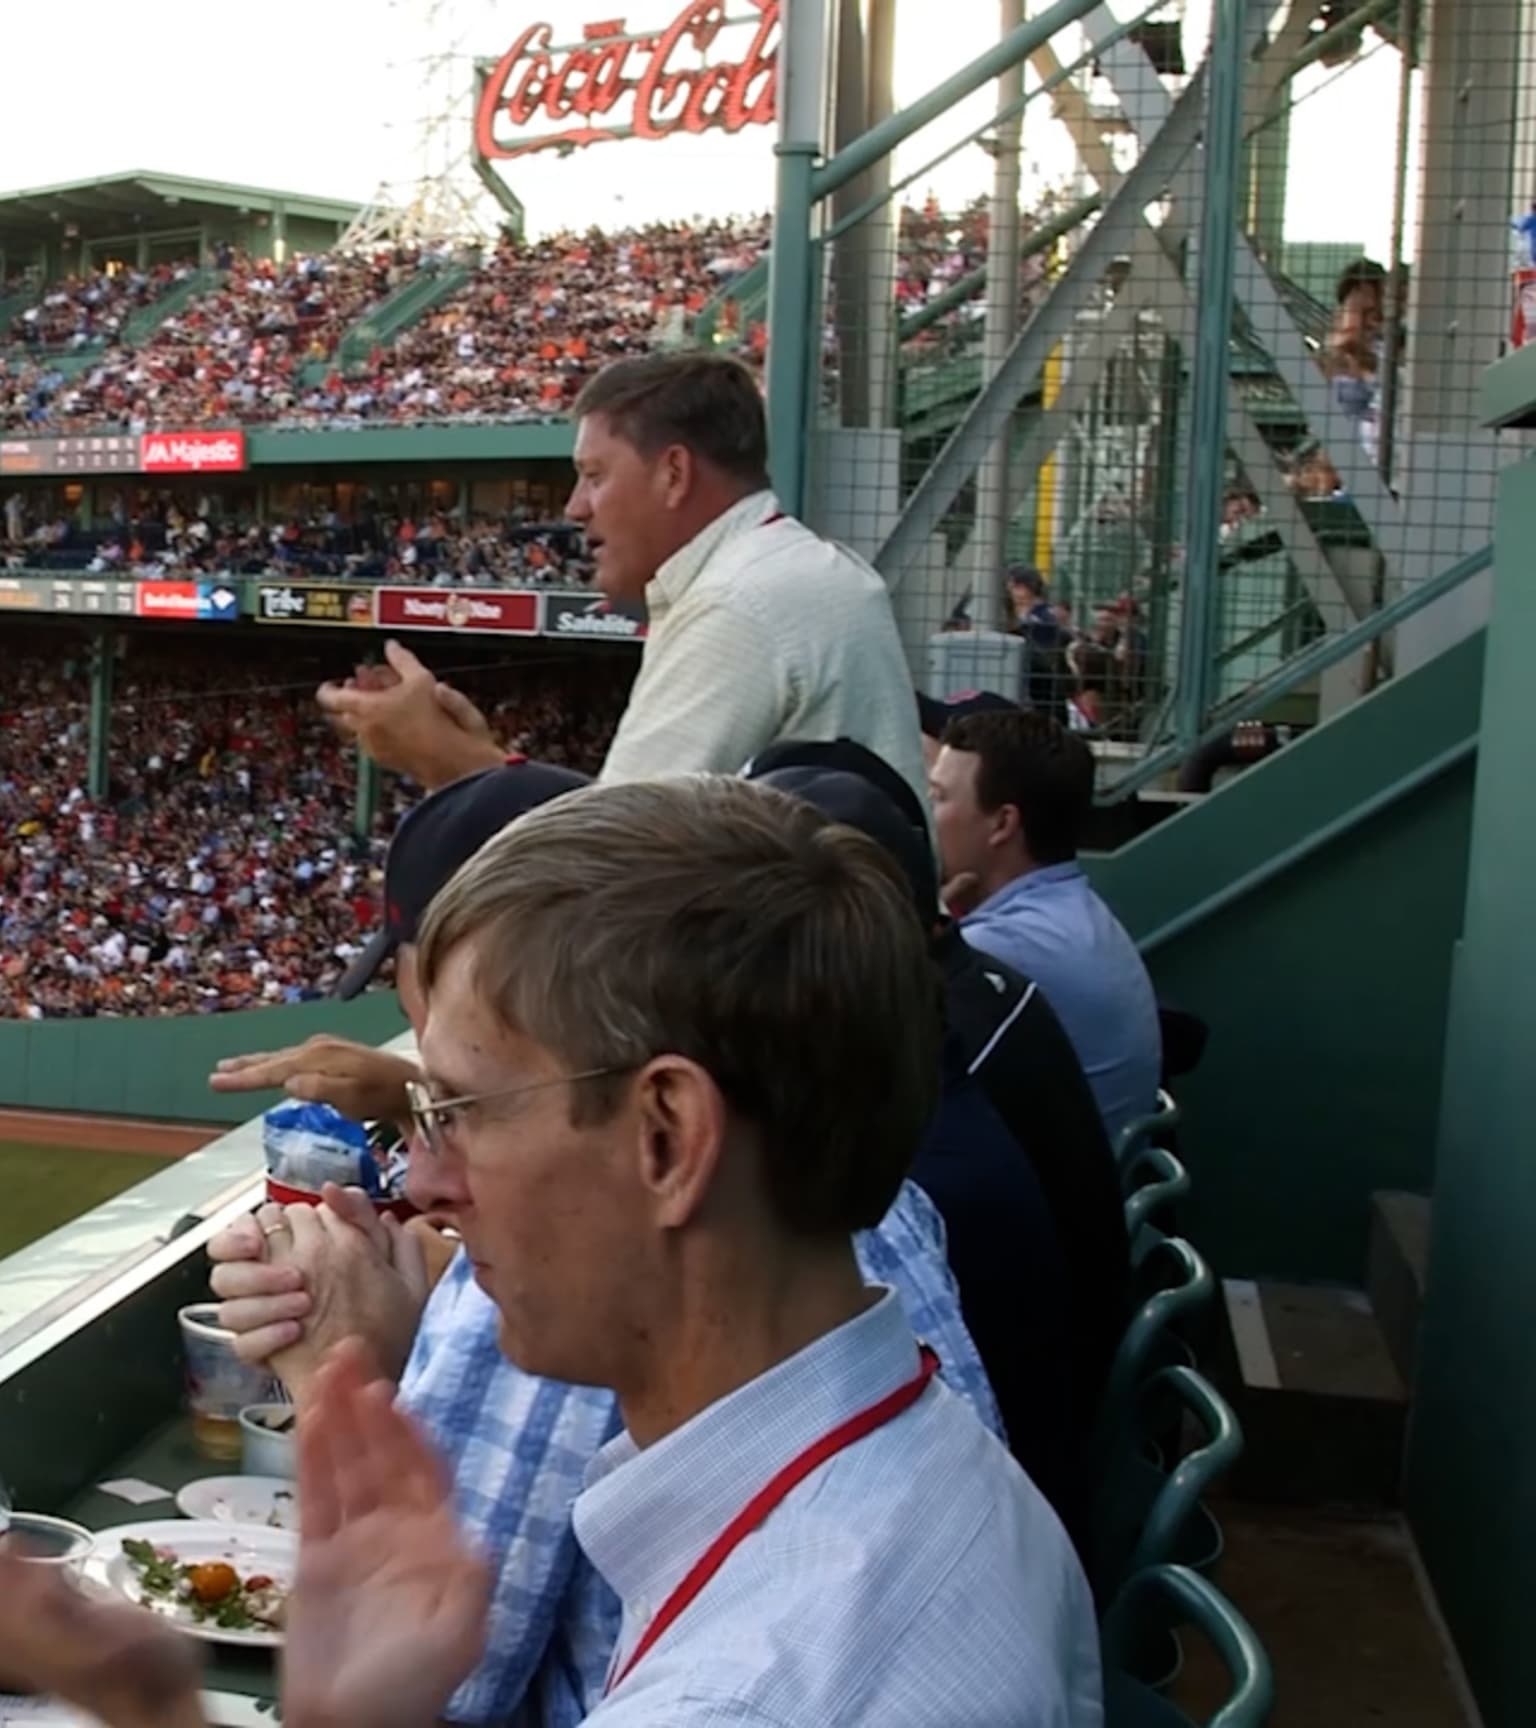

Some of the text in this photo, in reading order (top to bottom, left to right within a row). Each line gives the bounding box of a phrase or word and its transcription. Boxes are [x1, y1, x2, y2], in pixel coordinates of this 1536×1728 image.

[170, 440, 239, 470] Majestic
[260, 587, 305, 613] Tribe
[556, 611, 639, 635] Safelite
